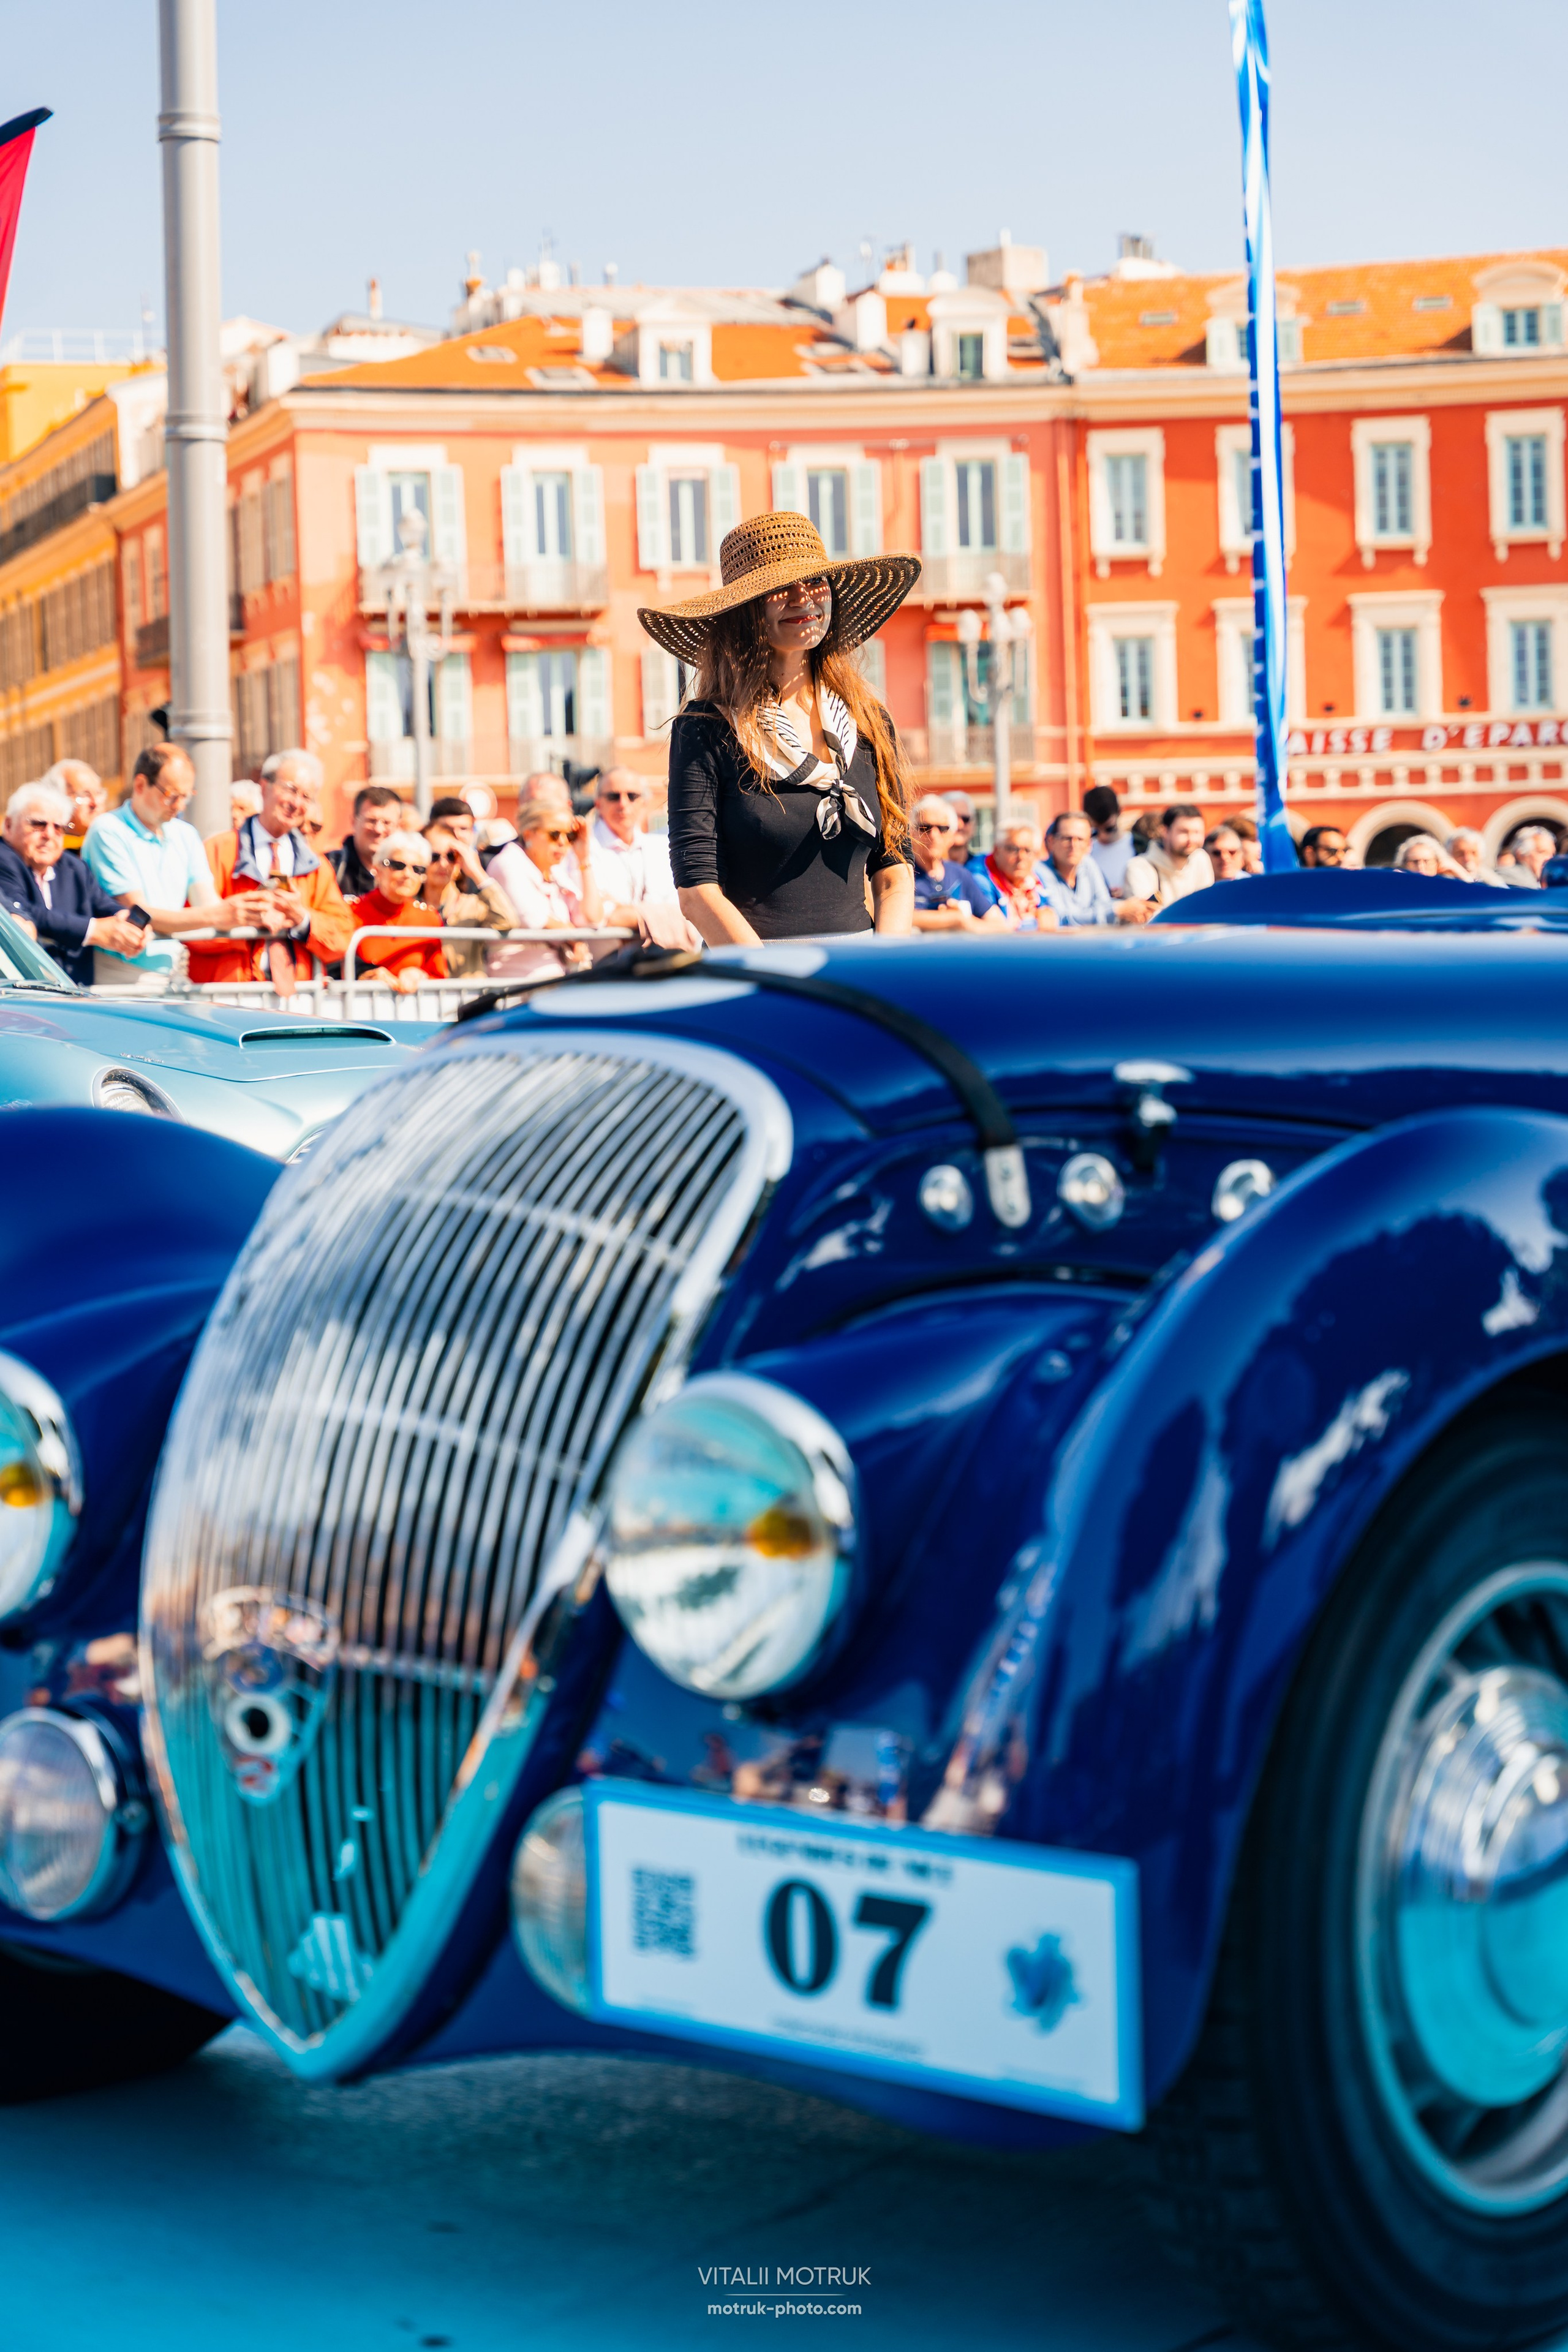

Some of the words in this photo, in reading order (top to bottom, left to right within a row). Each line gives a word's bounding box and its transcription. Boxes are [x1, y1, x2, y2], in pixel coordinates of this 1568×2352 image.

[1286, 726, 1393, 757] AISSE
[1422, 720, 1568, 752] D'EPAR
[764, 1879, 932, 2012] 07
